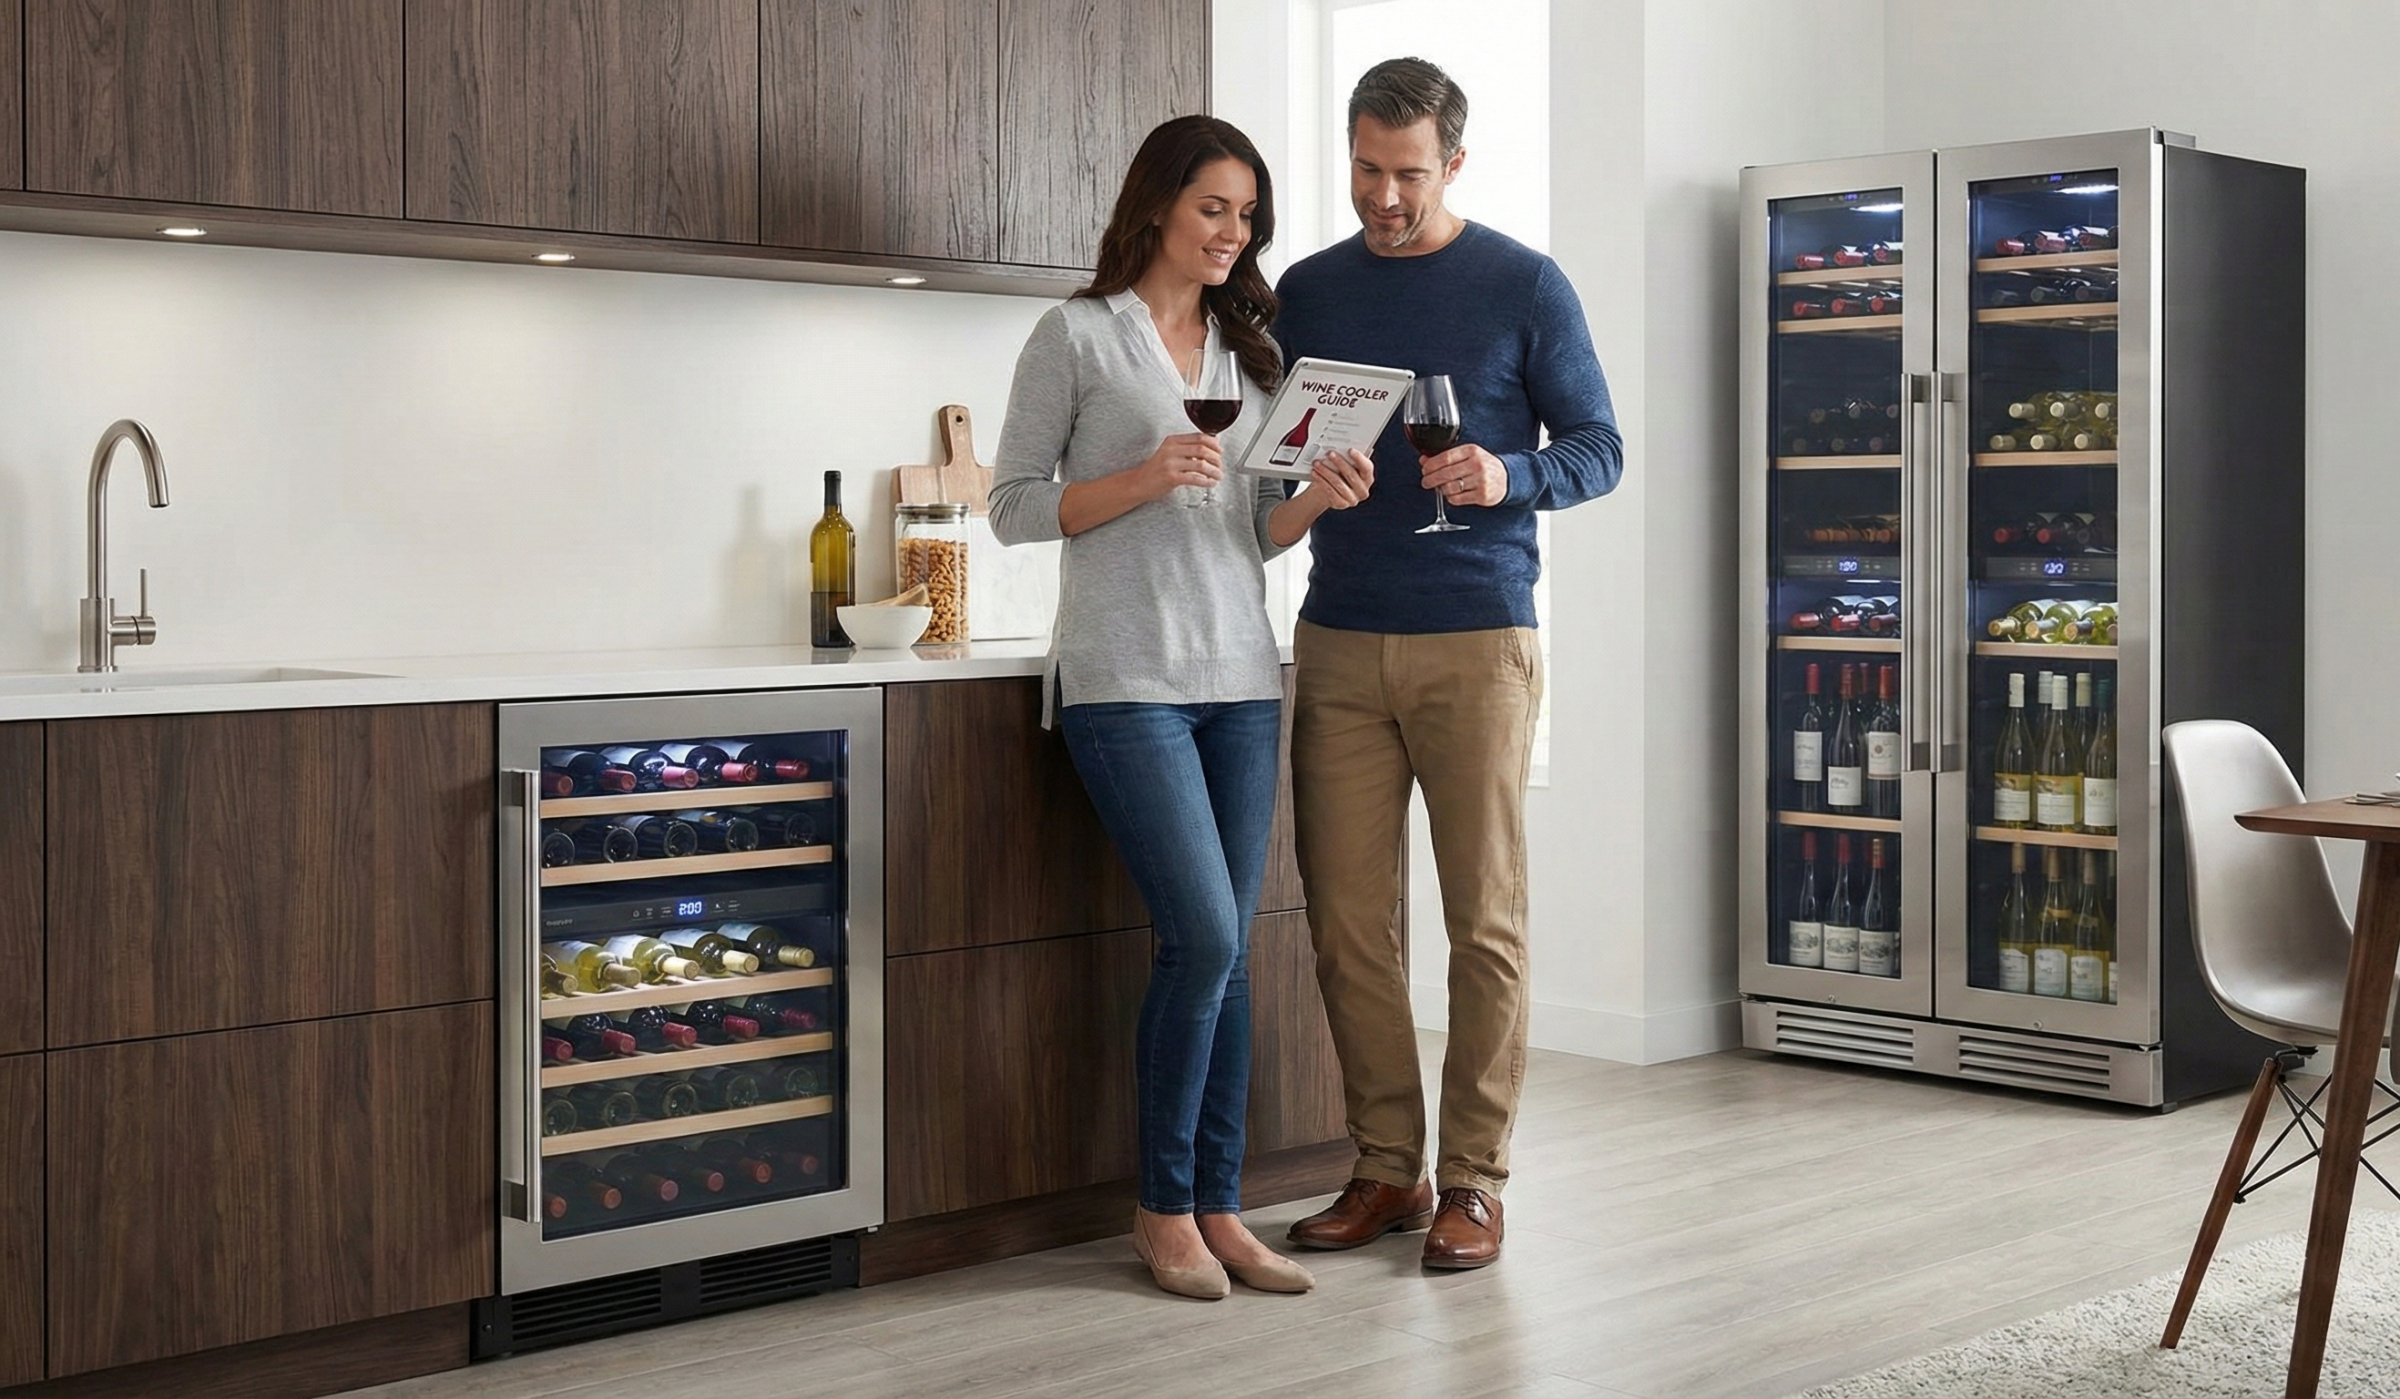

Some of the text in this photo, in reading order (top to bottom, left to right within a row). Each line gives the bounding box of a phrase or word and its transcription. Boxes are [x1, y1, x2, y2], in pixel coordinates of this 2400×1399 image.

[1302, 380, 1389, 401] WINE COOLER
[1317, 394, 1358, 408] GUIDE
